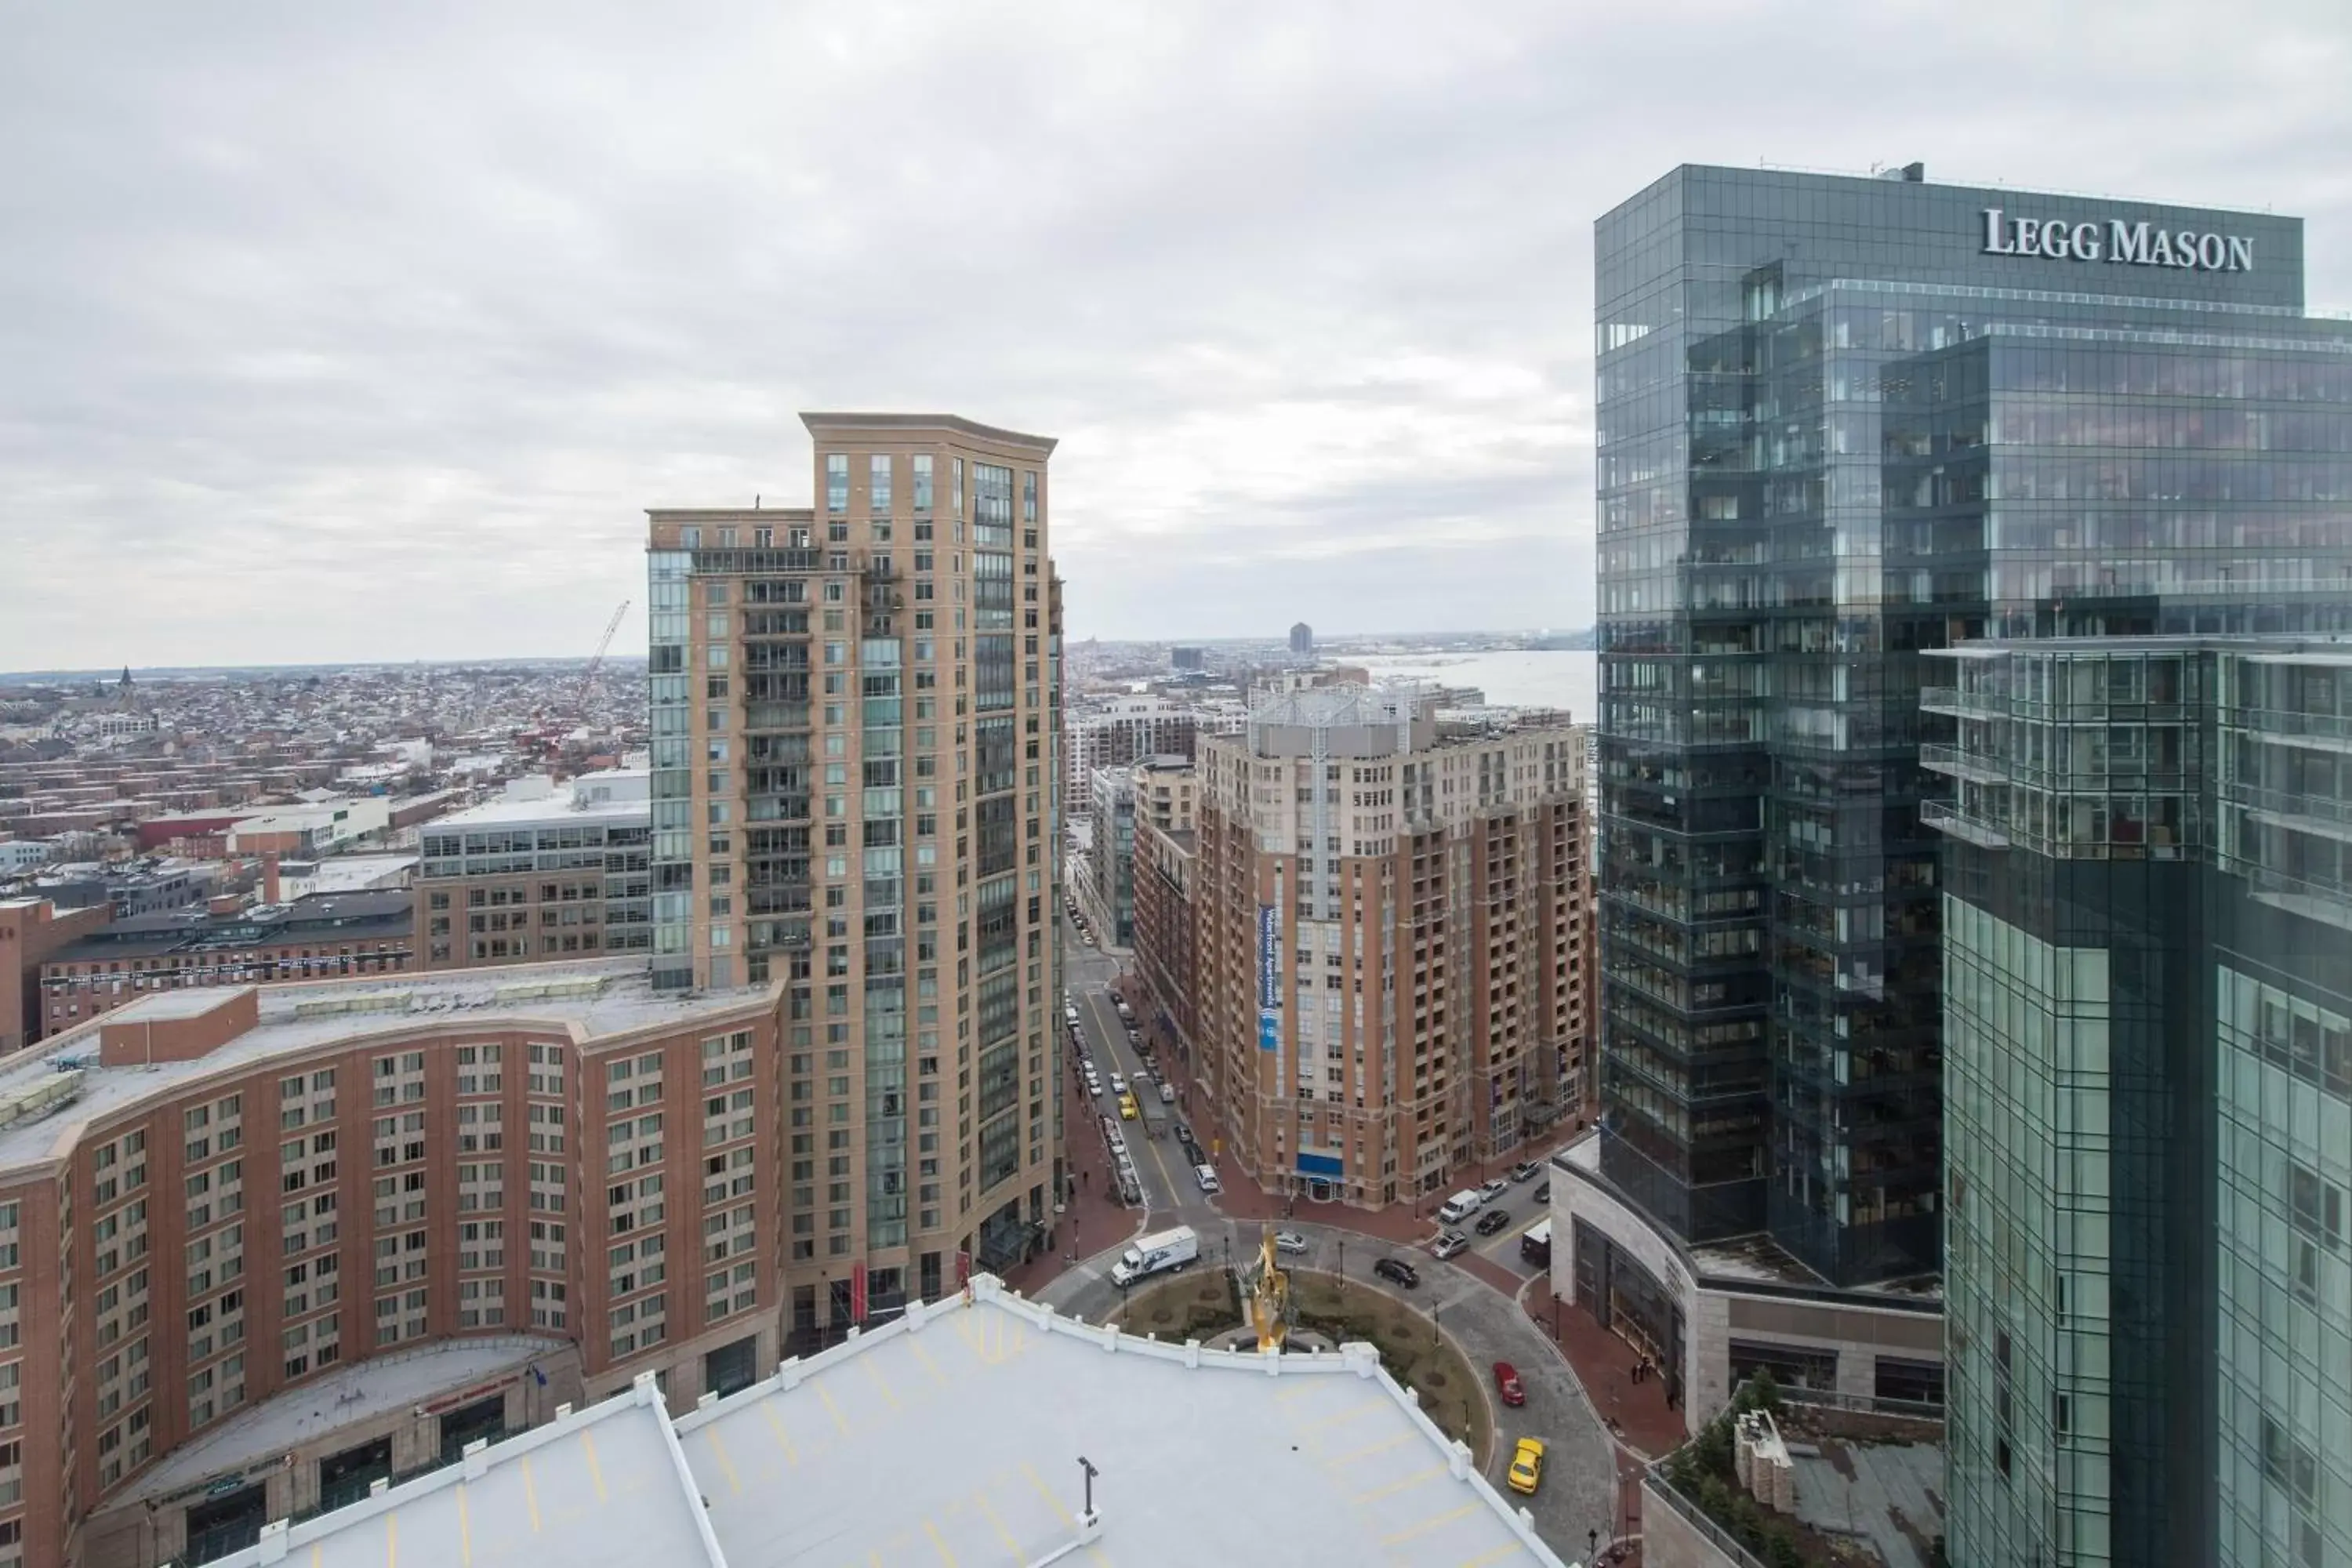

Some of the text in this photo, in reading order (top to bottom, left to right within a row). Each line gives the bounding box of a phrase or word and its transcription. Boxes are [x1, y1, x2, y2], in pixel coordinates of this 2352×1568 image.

[1984, 209, 2254, 272] LEGG MASON
[1265, 909, 1276, 1006] Waterfront Apartments
